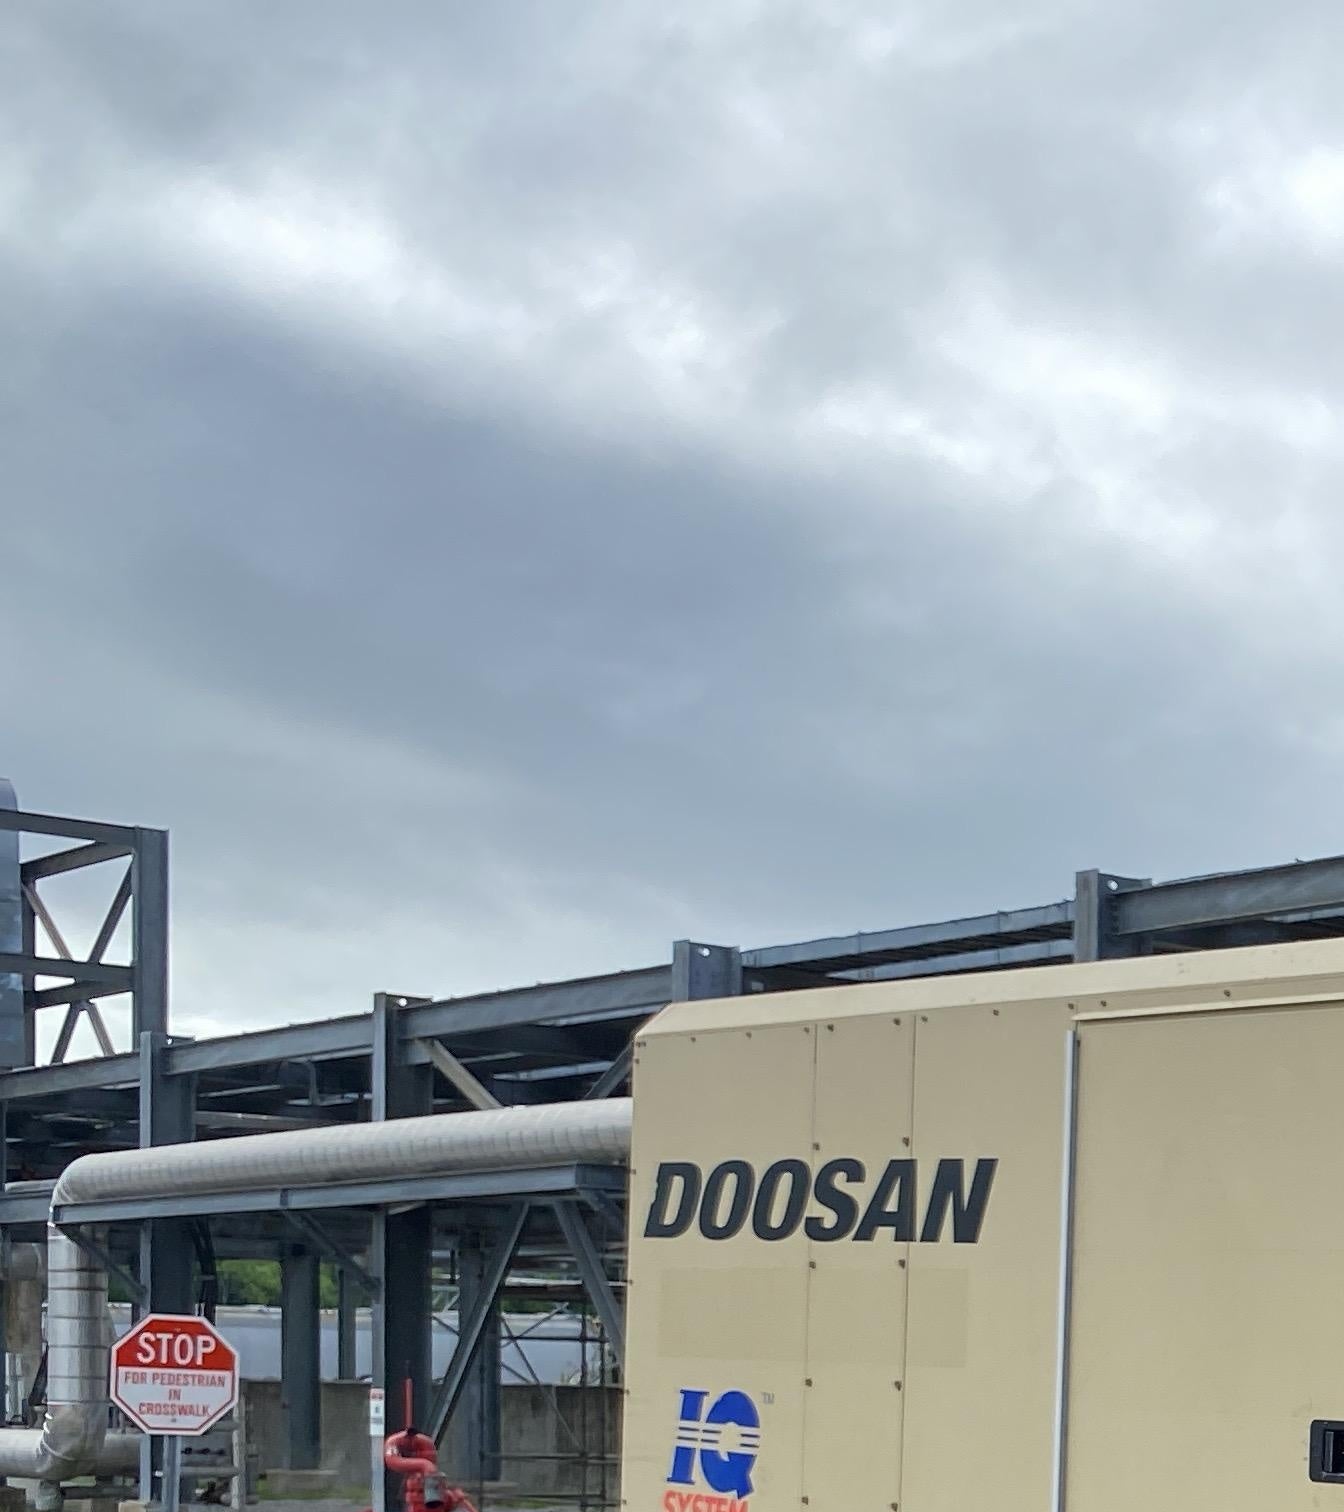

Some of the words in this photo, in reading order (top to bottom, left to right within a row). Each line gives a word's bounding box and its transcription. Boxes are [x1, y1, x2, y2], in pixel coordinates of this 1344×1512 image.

[643, 1157, 998, 1244] DOOSAN
[136, 1331, 216, 1366] STOP
[124, 1371, 147, 1385] FOR
[151, 1372, 226, 1387] PEDESTRIAN
[168, 1388, 182, 1401] IN
[138, 1402, 211, 1416] CROSSWALK
[666, 1389, 761, 1500] IQ
